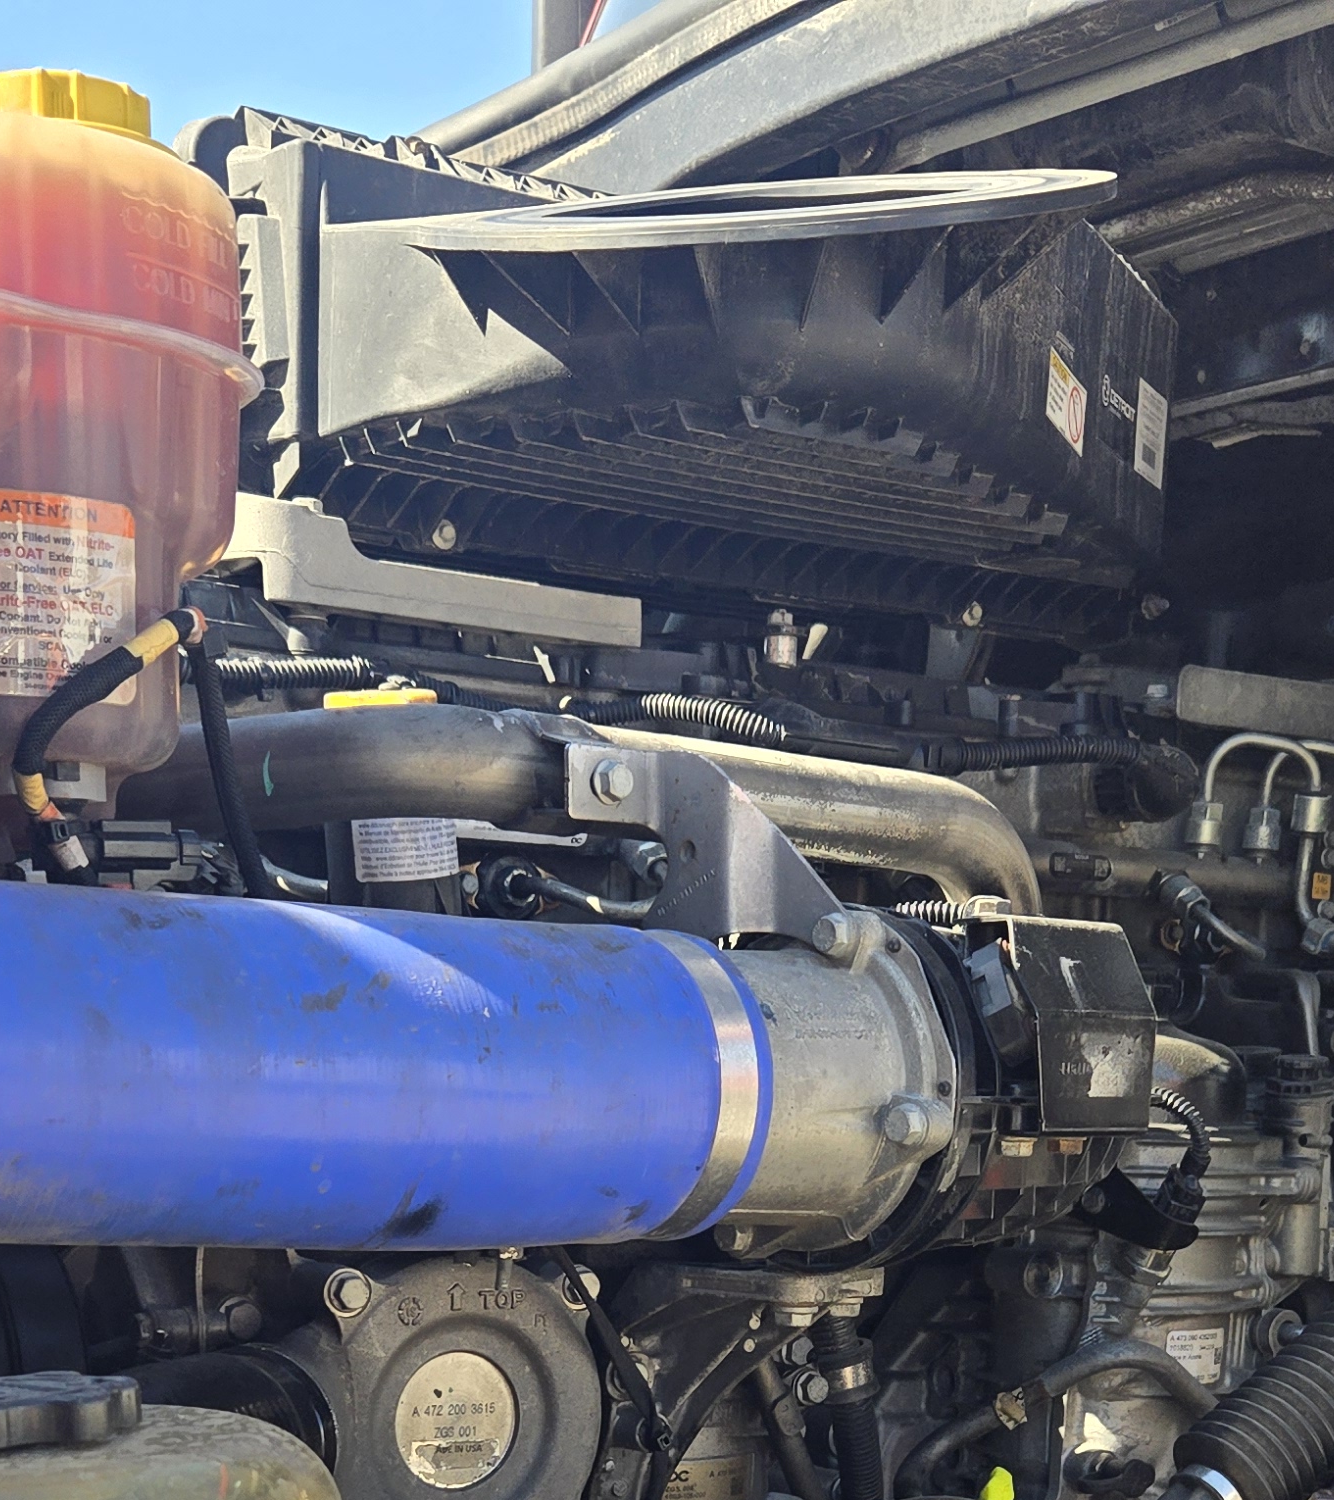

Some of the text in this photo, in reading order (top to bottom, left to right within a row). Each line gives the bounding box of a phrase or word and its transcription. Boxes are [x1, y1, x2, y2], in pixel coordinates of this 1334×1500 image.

[120, 205, 190, 249] COLD
[133, 264, 195, 305] COLD
[0, 500, 97, 523] ATTENTION
[22, 531, 50, 543] Filled
[16, 547, 44, 560] OAT
[15, 562, 56, 576] Coolant
[92, 604, 114, 617] ELC
[47, 614, 61, 625] Do
[478, 1288, 526, 1310] TOP
[412, 1402, 496, 1417] A 472 200 3615
[434, 1426, 477, 1439] ZGS 001
[455, 1445, 464, 1453] IN
[466, 1444, 482, 1453] USA
